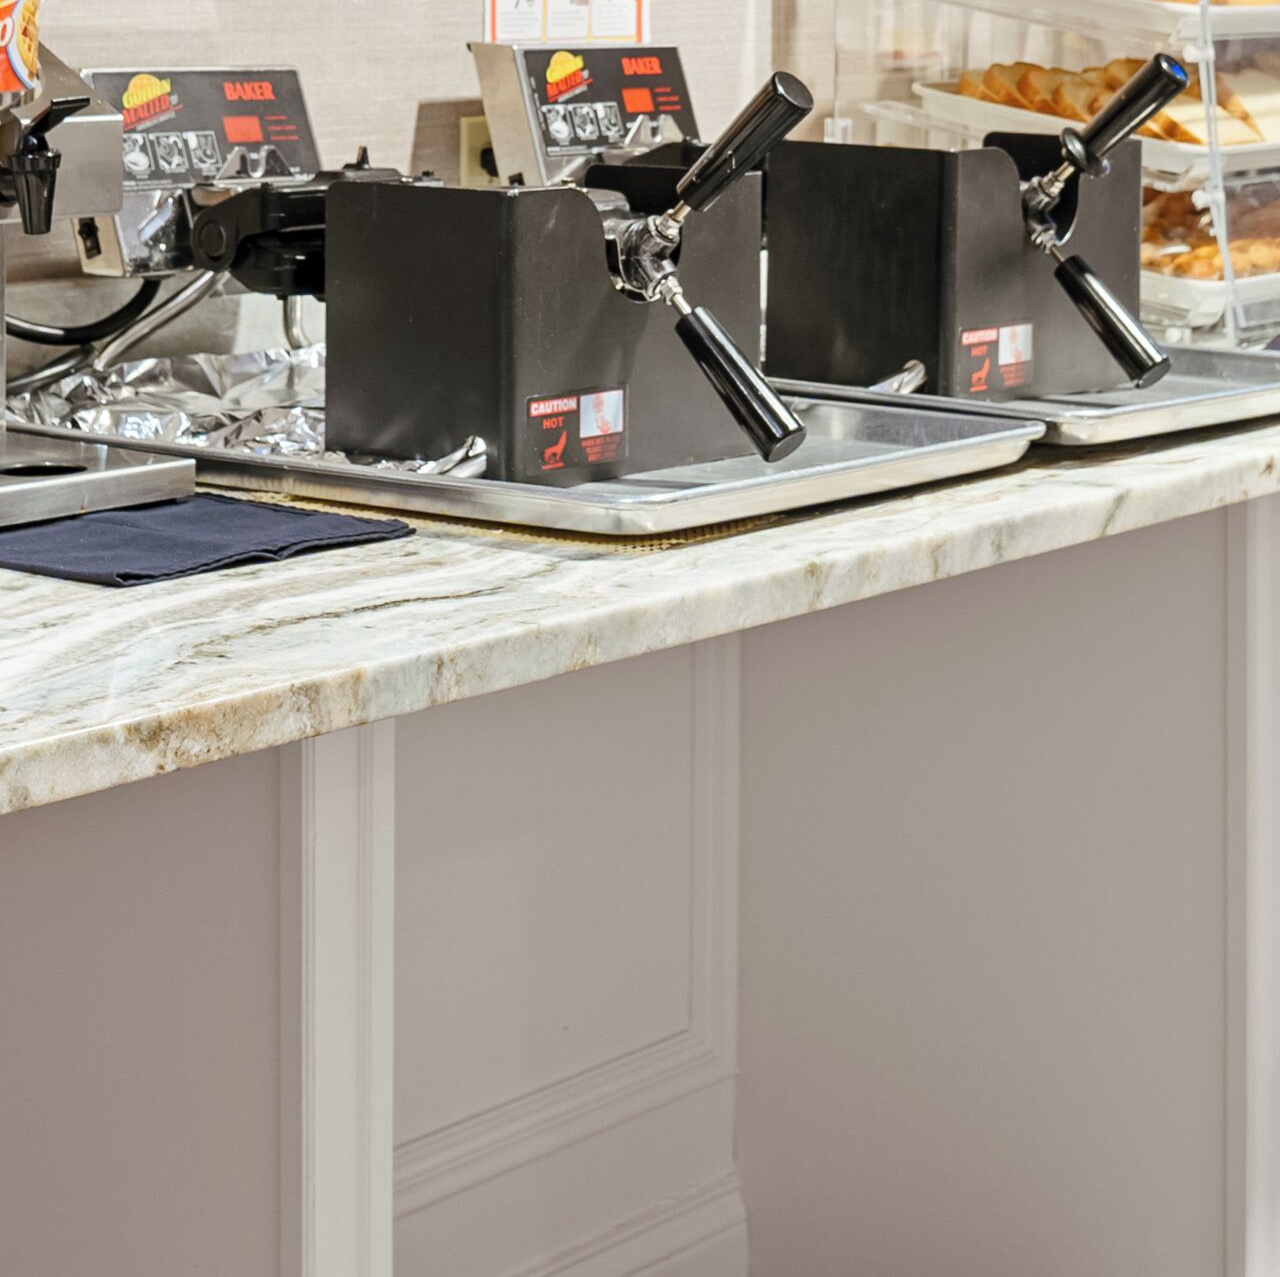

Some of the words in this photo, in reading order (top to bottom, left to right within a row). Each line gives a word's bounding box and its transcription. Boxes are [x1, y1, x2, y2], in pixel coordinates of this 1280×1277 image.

[621, 57, 662, 76] BAKER
[223, 81, 276, 101] BAKER
[530, 397, 577, 416] CAUTION
[543, 416, 565, 429] HOT
